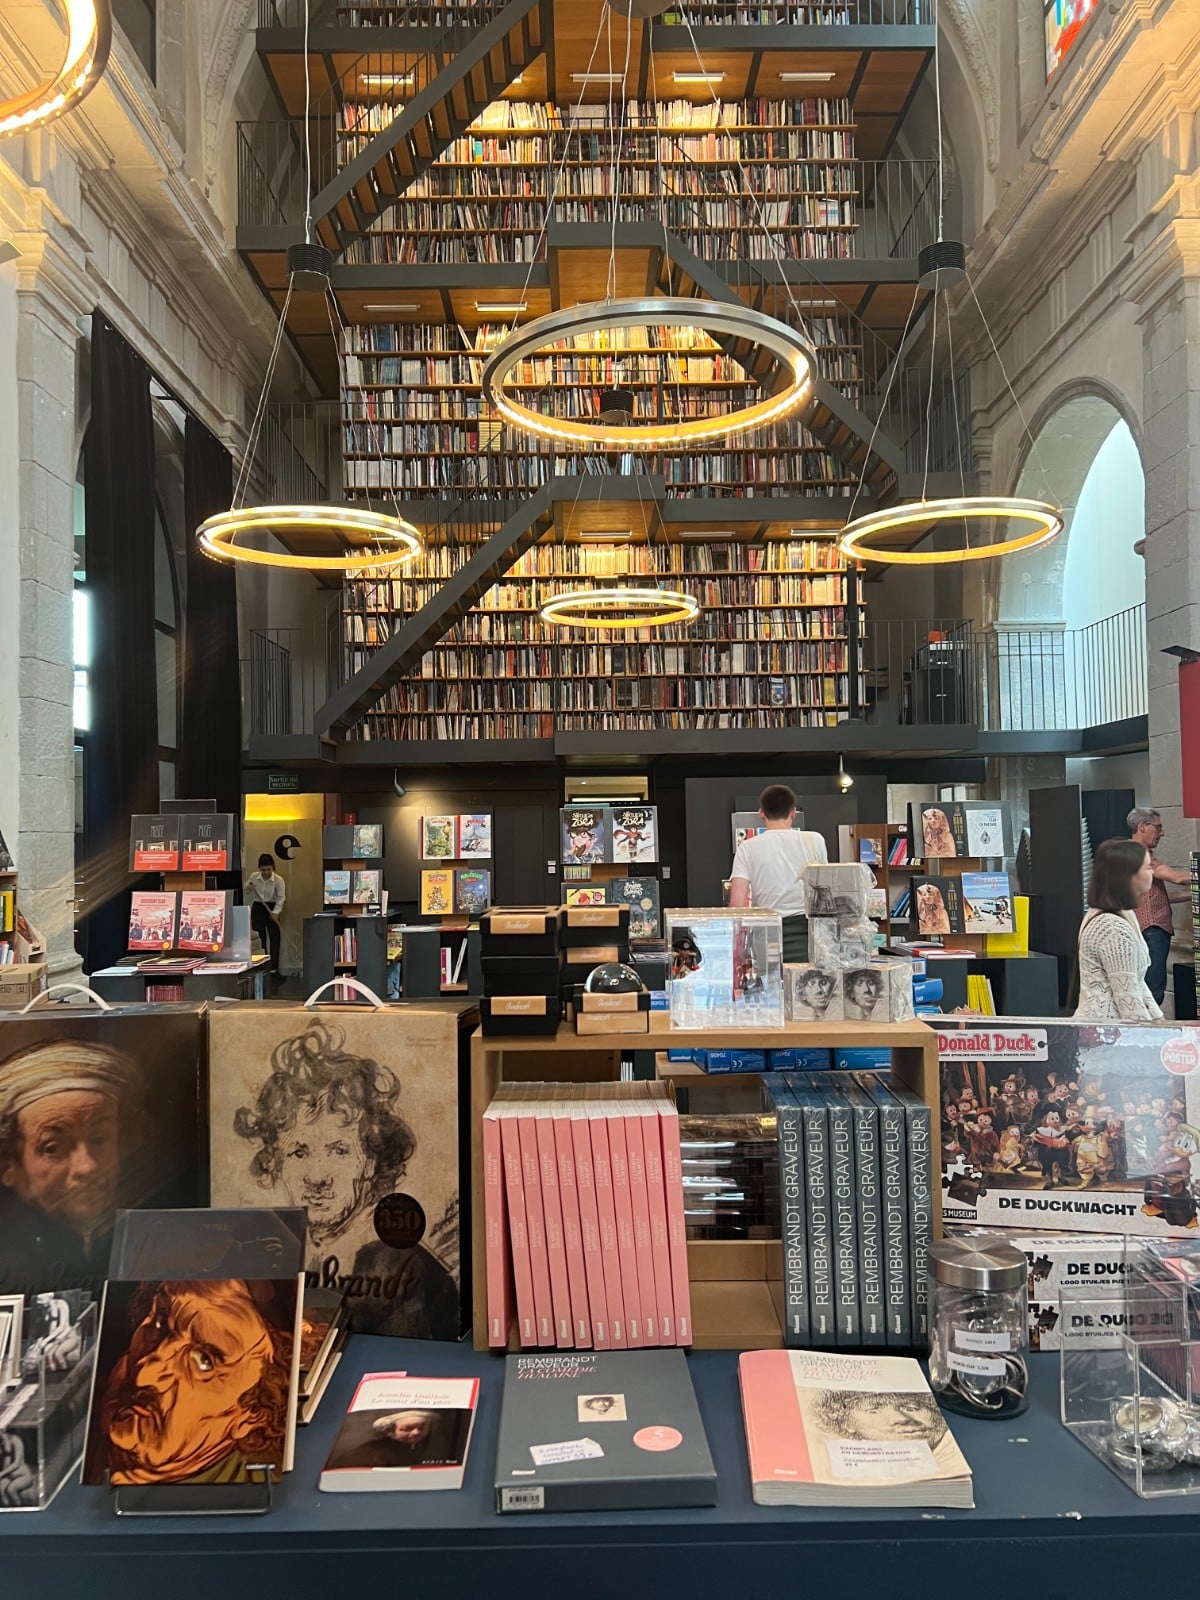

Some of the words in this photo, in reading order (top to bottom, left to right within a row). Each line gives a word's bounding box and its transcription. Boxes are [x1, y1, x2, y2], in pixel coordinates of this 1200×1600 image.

[938, 1033, 991, 1052] Donald
[992, 1033, 1036, 1052] Duck
[1163, 1051, 1196, 1065] POSTER
[783, 1119, 799, 1198] GRAVEUR
[809, 1119, 825, 1198] GRAVEUR
[834, 1119, 851, 1198] GRAVEUR
[859, 1118, 876, 1198] GRAVEUR
[885, 1119, 900, 1198] GRAVEUR
[912, 1118, 928, 1198] GRAVEUR
[999, 1198, 1022, 1209] DE
[1025, 1199, 1137, 1216] DUCKWACHT
[786, 1202, 803, 1305] REMBRANDT
[811, 1202, 829, 1305] REMBRANDT
[837, 1202, 855, 1305] REMBRANDT
[862, 1202, 879, 1304] REMBRANDT
[888, 1202, 904, 1305] REMBRANDT
[1067, 1263, 1090, 1275] DE
[518, 1355, 598, 1364] REMBRANDT
[1071, 1315, 1094, 1327] DE
